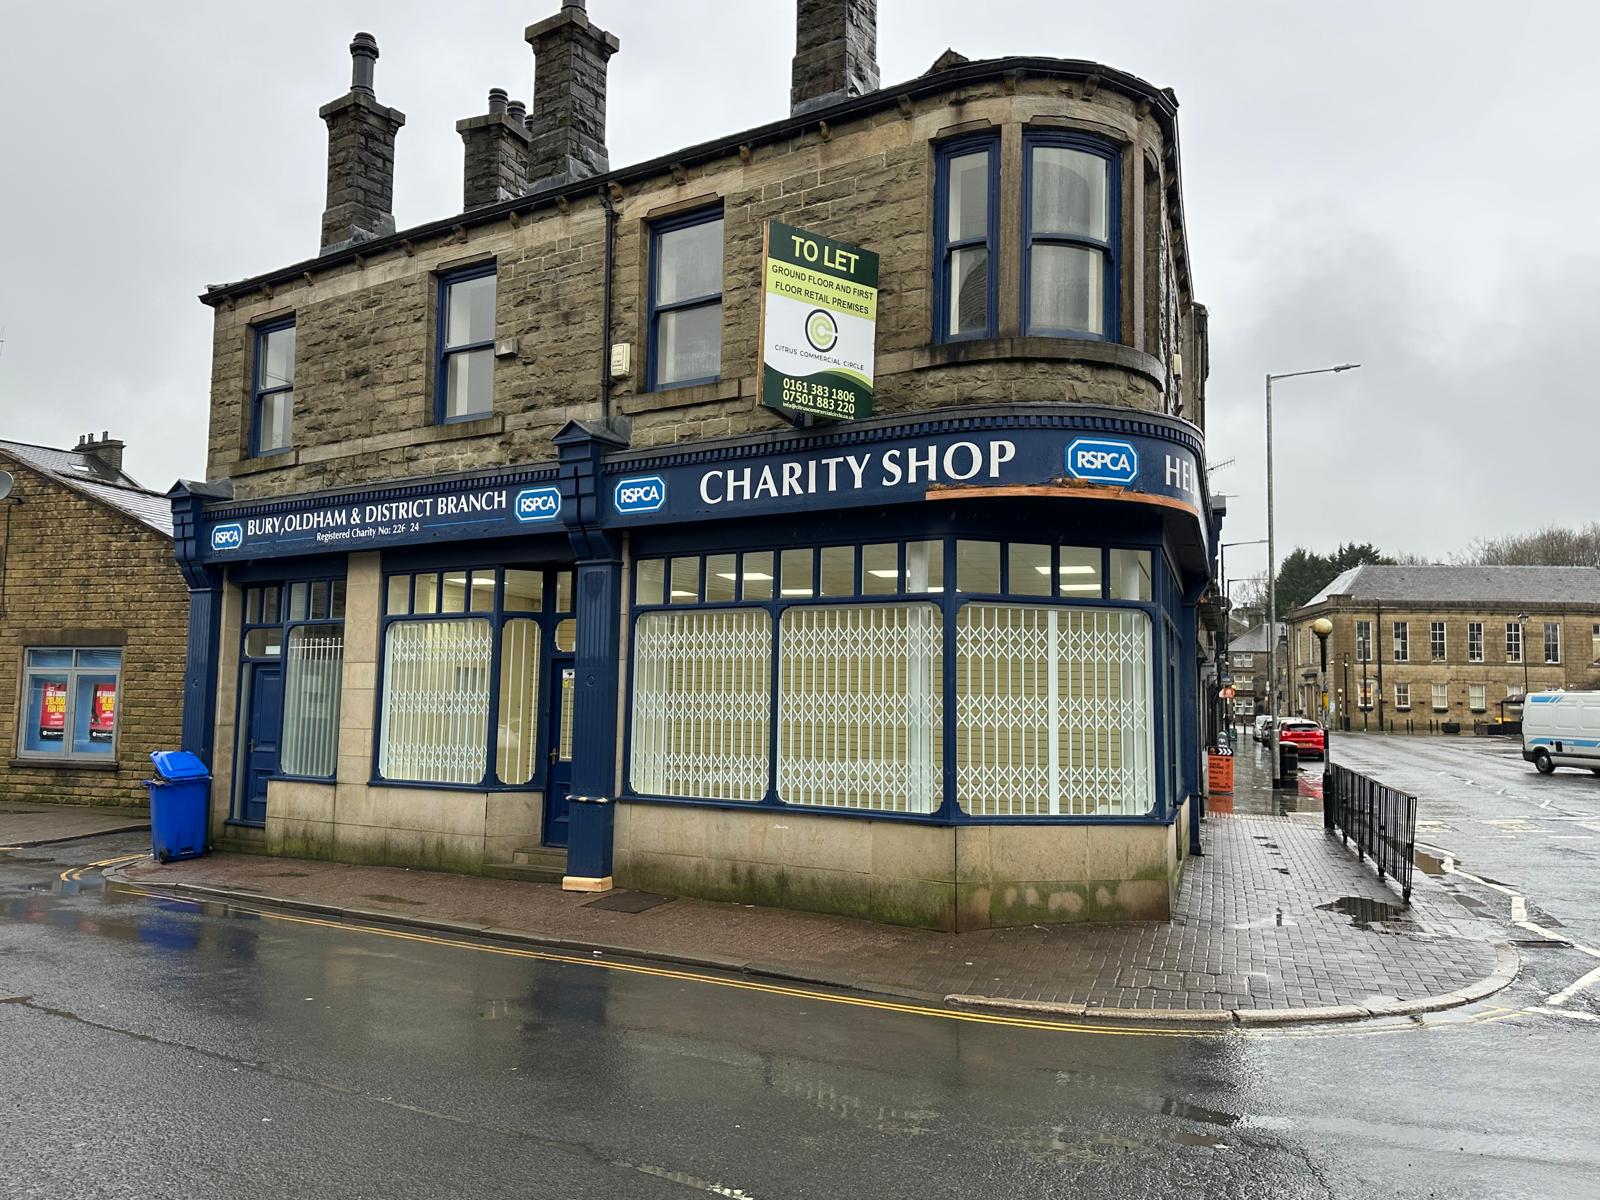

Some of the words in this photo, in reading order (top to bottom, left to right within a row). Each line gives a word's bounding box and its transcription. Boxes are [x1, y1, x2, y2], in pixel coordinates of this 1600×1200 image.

[791, 235, 818, 262] TO
[823, 245, 859, 274] LET
[772, 264, 807, 282] GROUND
[808, 274, 834, 290] FLOOR
[835, 282, 851, 295] AND
[852, 287, 873, 301] FIRST
[775, 281, 803, 296] FLOOR
[804, 289, 830, 305] RETAIL
[832, 296, 869, 315] PREMISES
[774, 344, 798, 355] CITRUS
[799, 350, 841, 366] COMMERCIAL
[843, 360, 864, 371] CIRCLE
[783, 378, 808, 393] 0161
[811, 384, 829, 397] 383
[831, 388, 855, 403] 1806
[783, 389, 814, 406] 07501
[816, 397, 834, 410] 883
[837, 401, 855, 414] 220
[699, 454, 871, 505] CHARITY
[881, 440, 1017, 487] SHOP
[1076, 450, 1131, 472] RSPCA
[350, 510, 361, 525] &
[365, 498, 433, 523] DISTRICT
[437, 490, 506, 515] BRANCH
[521, 495, 556, 513] RSPCA
[620, 485, 661, 505] RSPCA
[214, 530, 239, 543] RSPCA
[316, 529, 350, 543] Registered
[351, 526, 376, 539] Charity
[378, 526, 391, 535] No:
